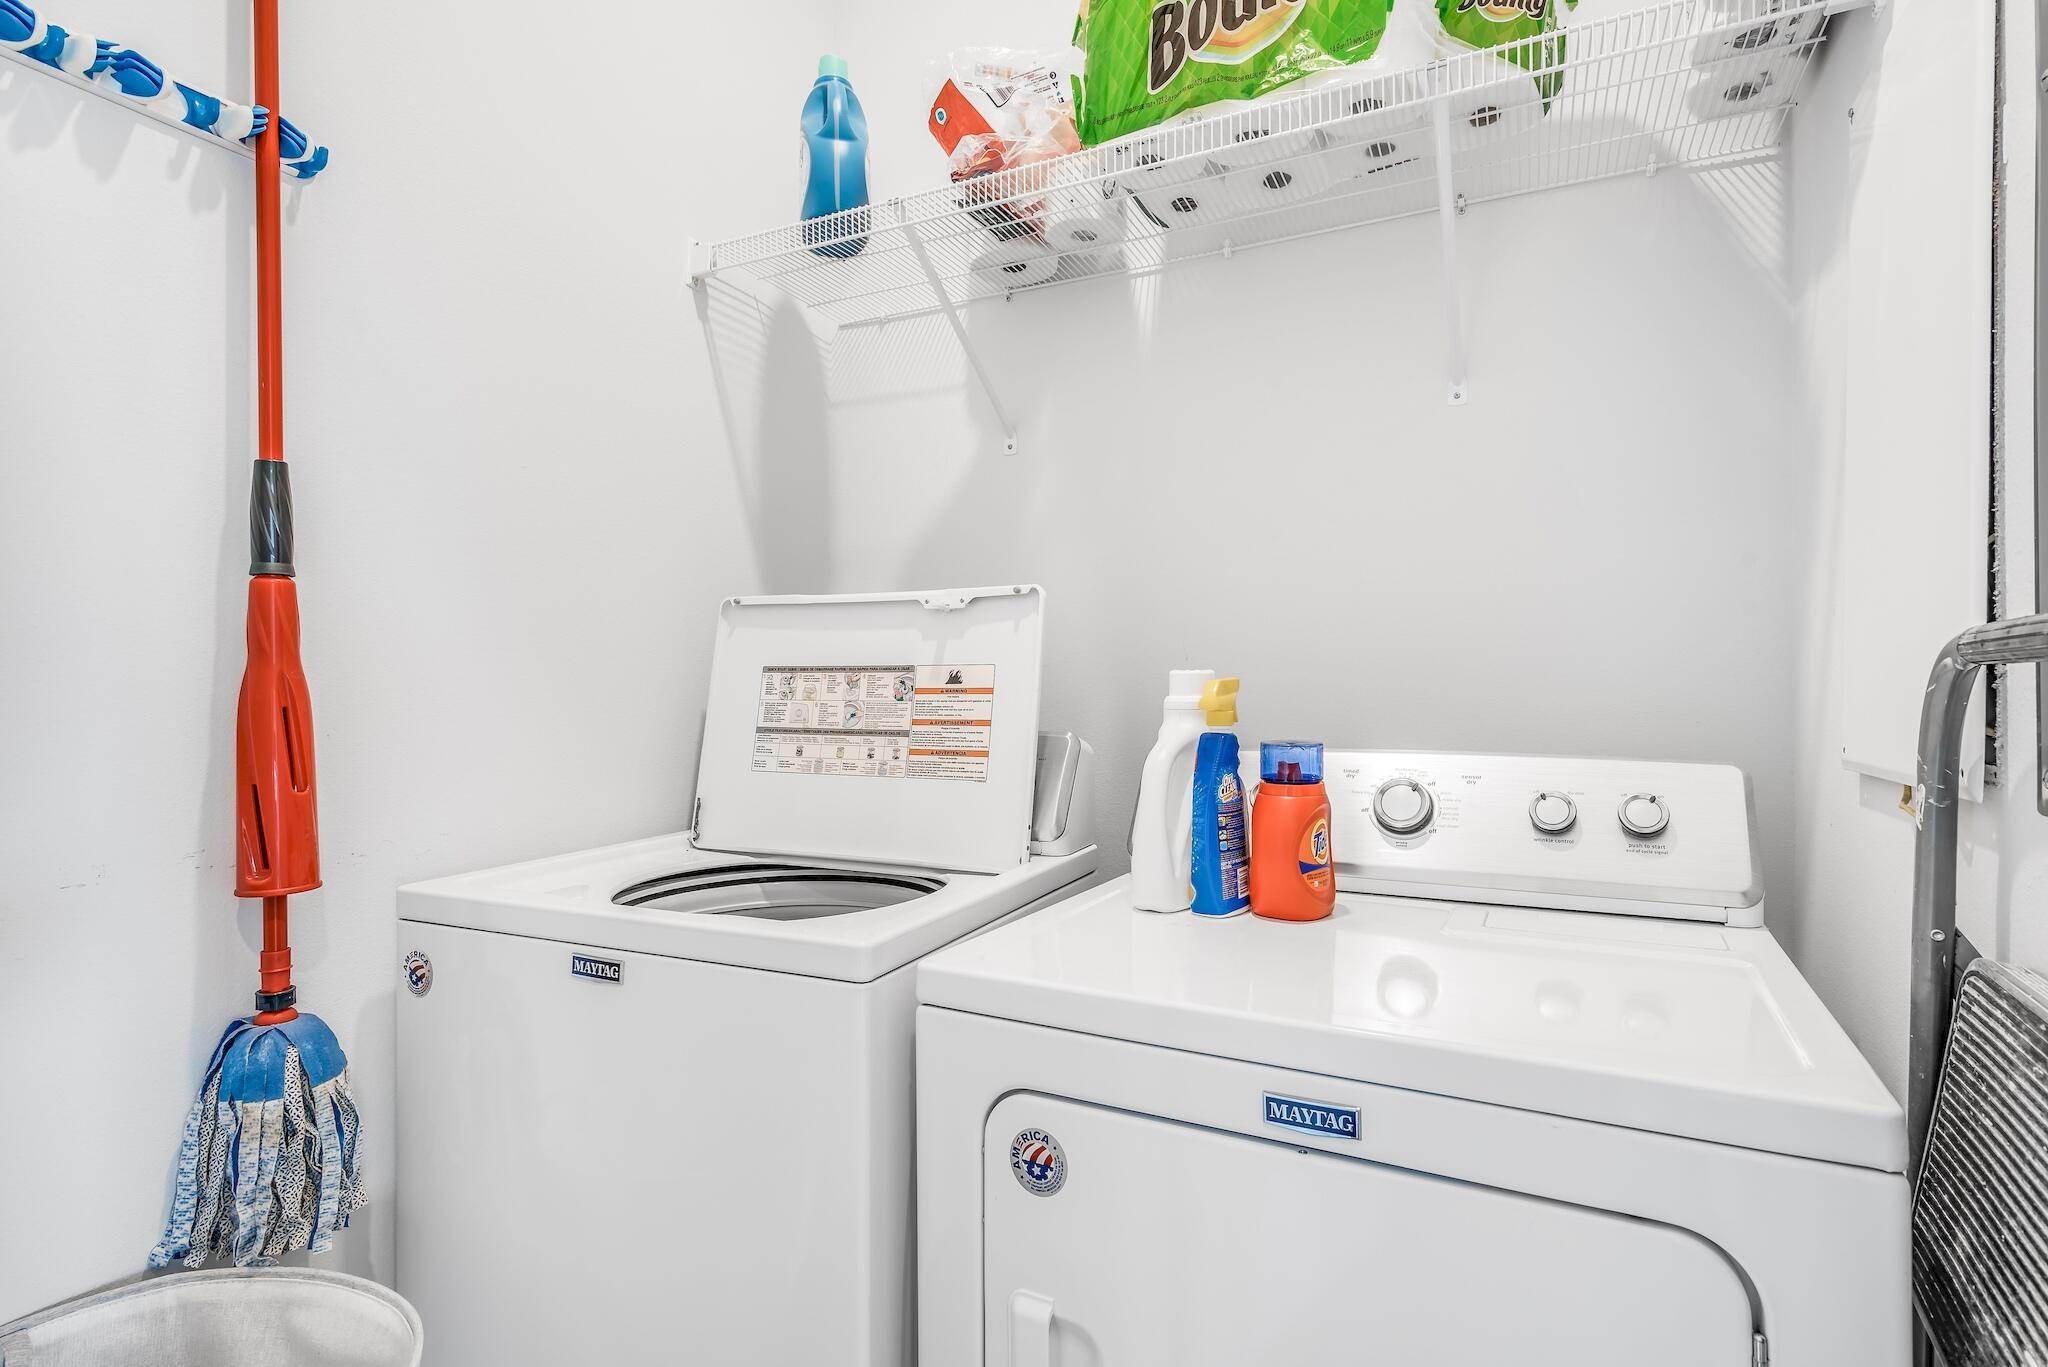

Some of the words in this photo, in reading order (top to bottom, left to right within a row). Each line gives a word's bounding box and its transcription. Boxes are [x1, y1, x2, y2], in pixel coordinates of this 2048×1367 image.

[1150, 0, 1299, 91] Bou
[403, 950, 429, 971] AMERICA
[573, 959, 619, 979] MAYTAG
[1268, 1101, 1354, 1132] MAYTAG
[1012, 1131, 1050, 1170] AMERICA
